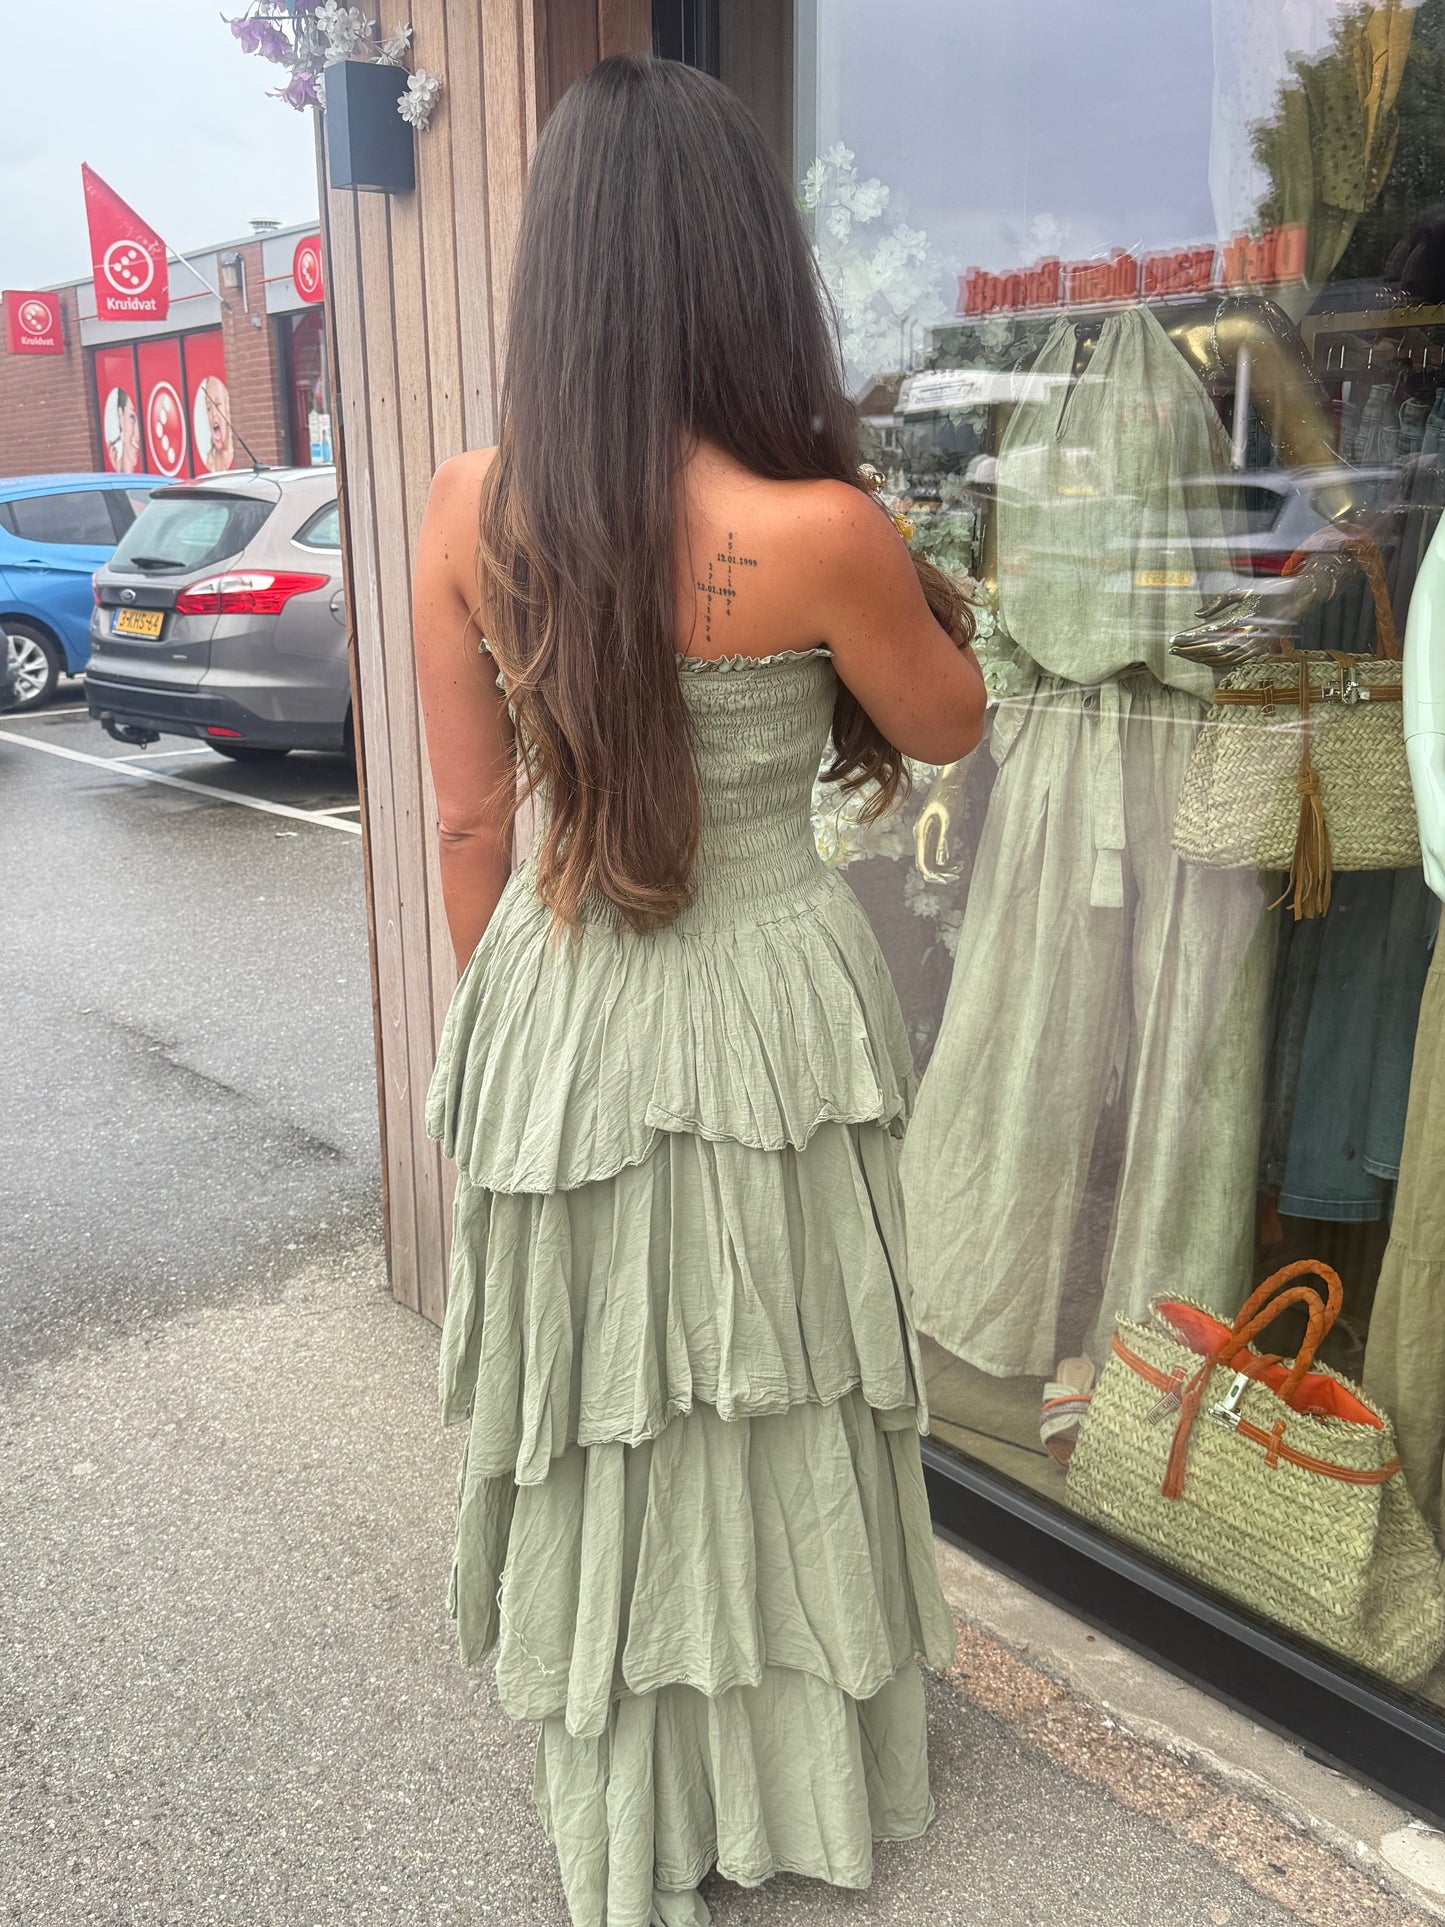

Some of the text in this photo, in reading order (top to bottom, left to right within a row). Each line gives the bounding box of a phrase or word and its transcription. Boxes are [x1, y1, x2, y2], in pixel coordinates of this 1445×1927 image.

[106, 297, 157, 311] Kruidvat
[20, 336, 55, 346] Kruidvat
[119, 610, 160, 632] 3-KHS-64
